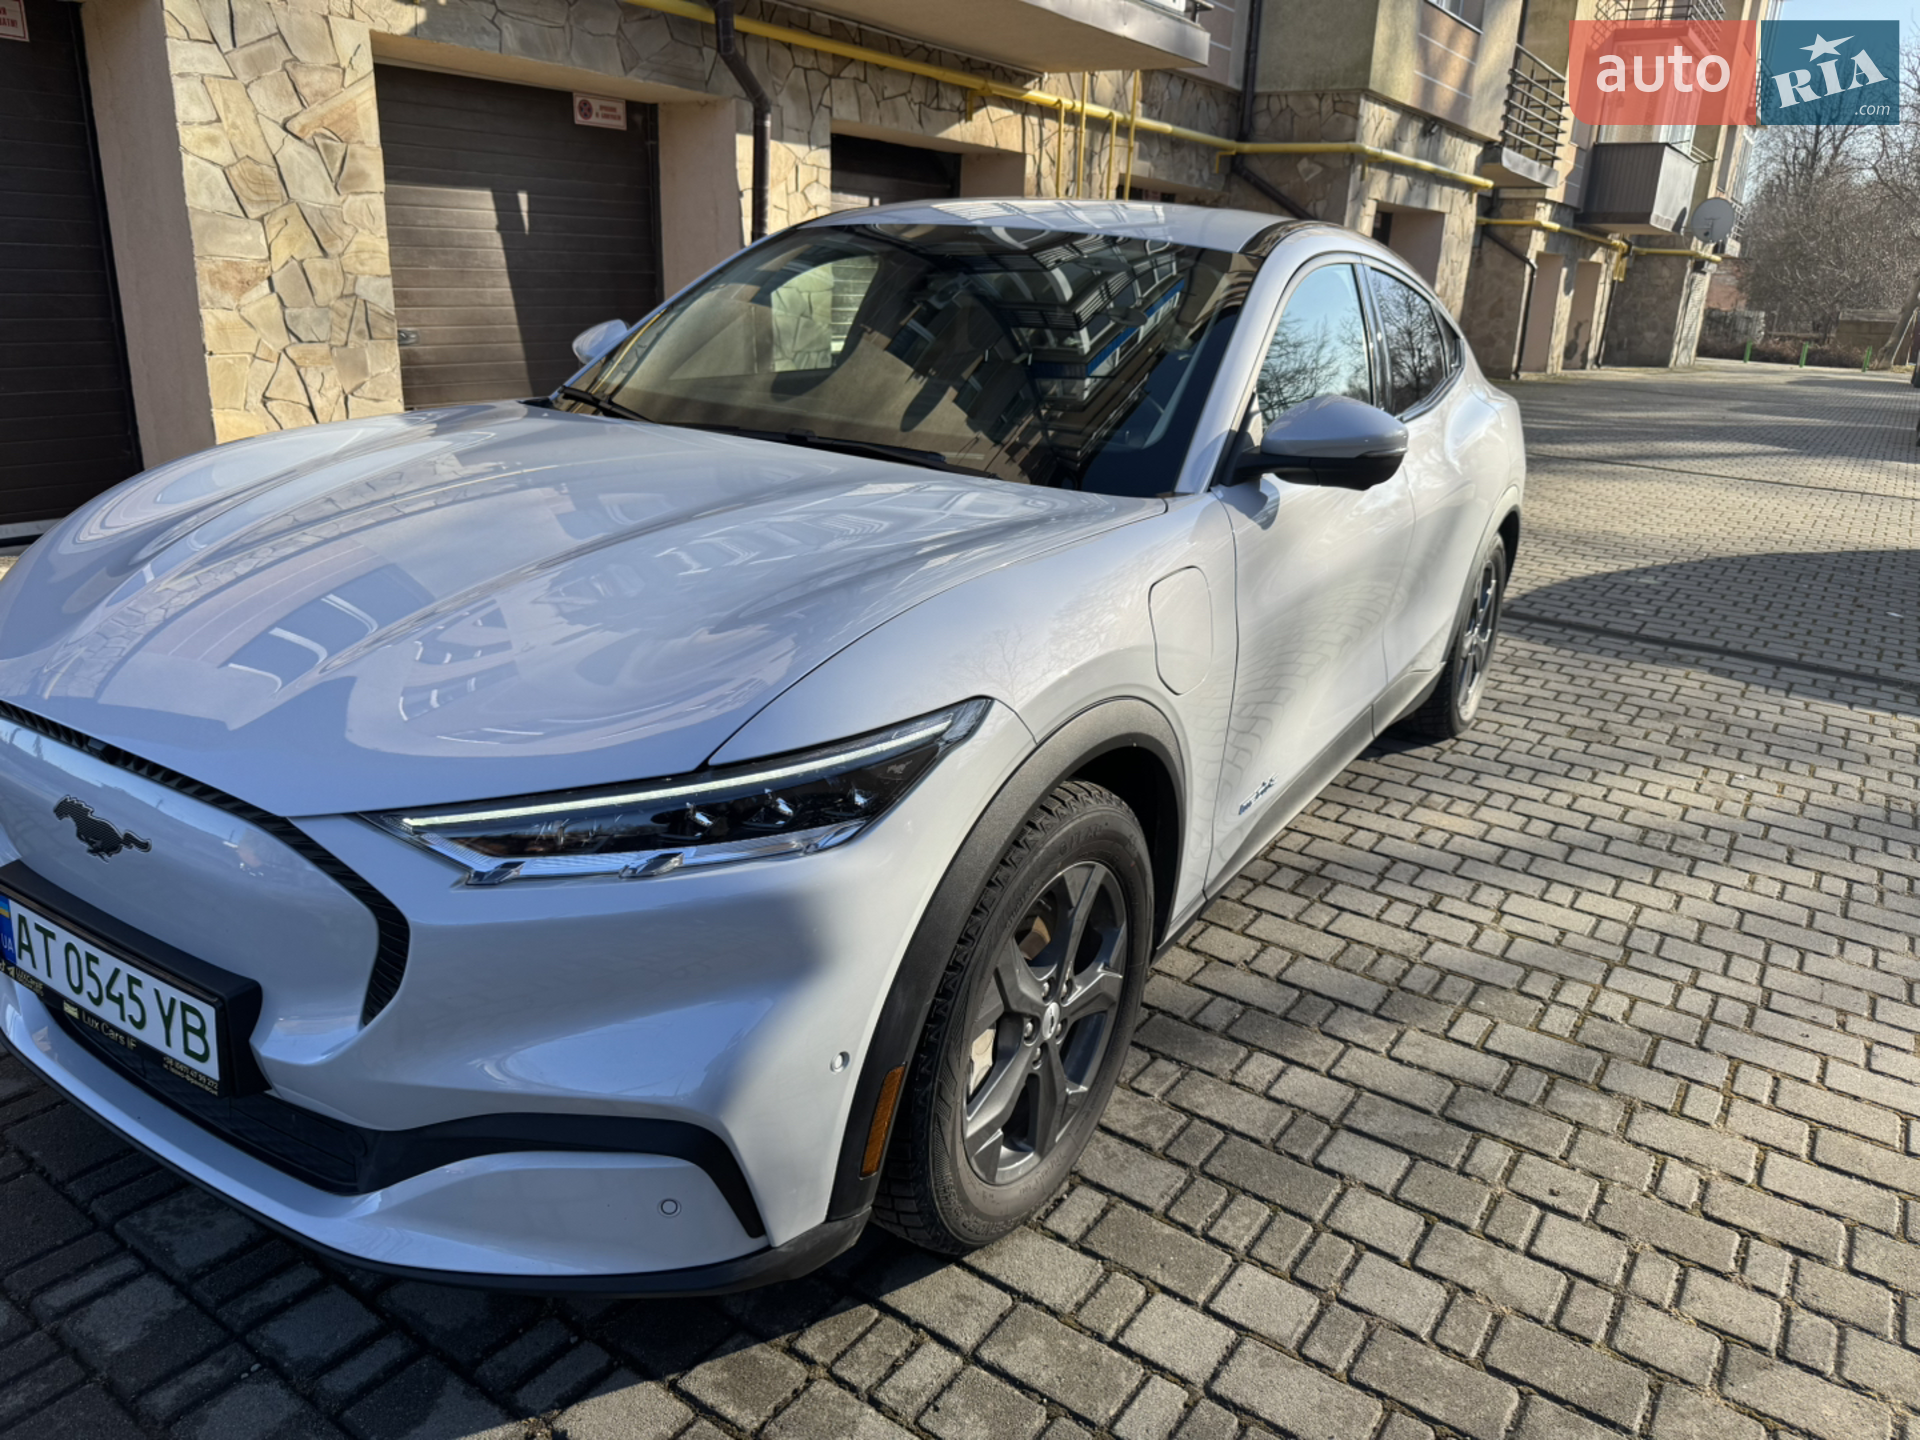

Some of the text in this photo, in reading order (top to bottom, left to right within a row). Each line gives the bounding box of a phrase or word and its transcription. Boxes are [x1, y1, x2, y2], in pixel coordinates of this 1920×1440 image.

[1, 933, 14, 953] UA
[18, 912, 210, 1063] AT 0545 YB
[82, 1010, 137, 1050] Lux Cars IF
